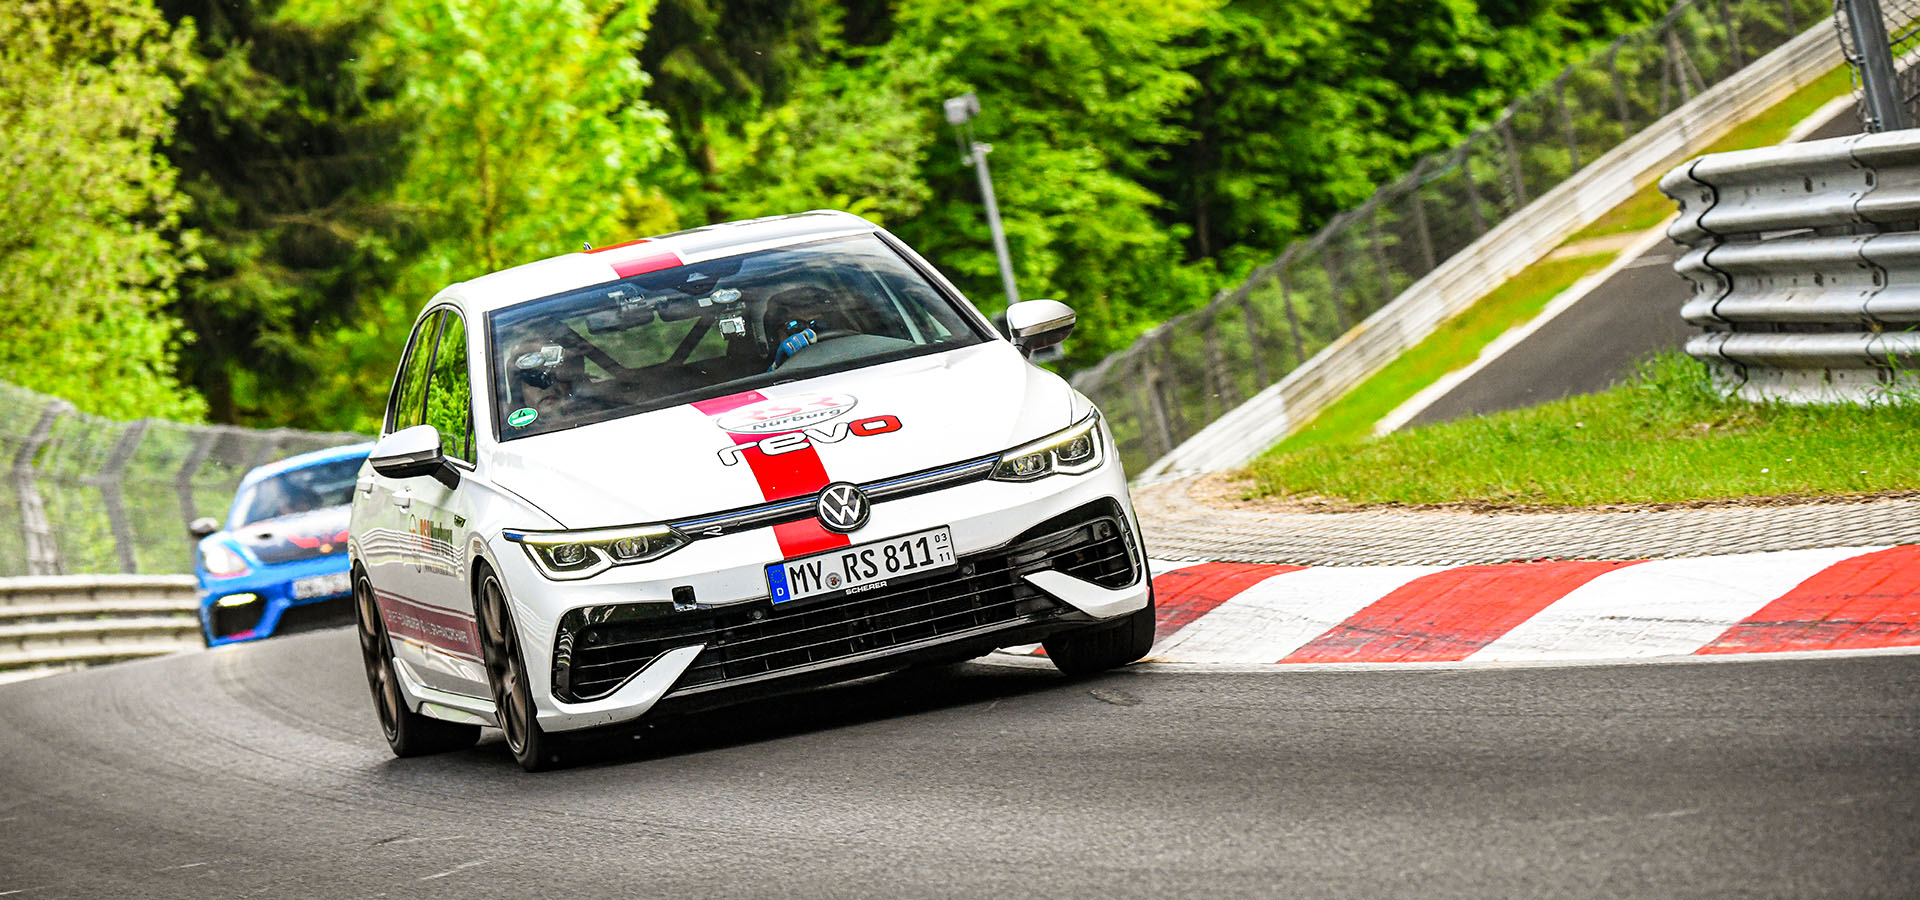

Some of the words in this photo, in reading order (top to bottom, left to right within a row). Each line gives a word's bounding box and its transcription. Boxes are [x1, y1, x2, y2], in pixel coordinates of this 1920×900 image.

[717, 414, 903, 466] revo
[934, 532, 948, 543] 03
[939, 551, 951, 562] 11
[789, 560, 822, 595] MY
[842, 549, 878, 583] RS
[883, 537, 934, 573] 811
[776, 587, 785, 597] D
[845, 580, 888, 596] SCHERER
